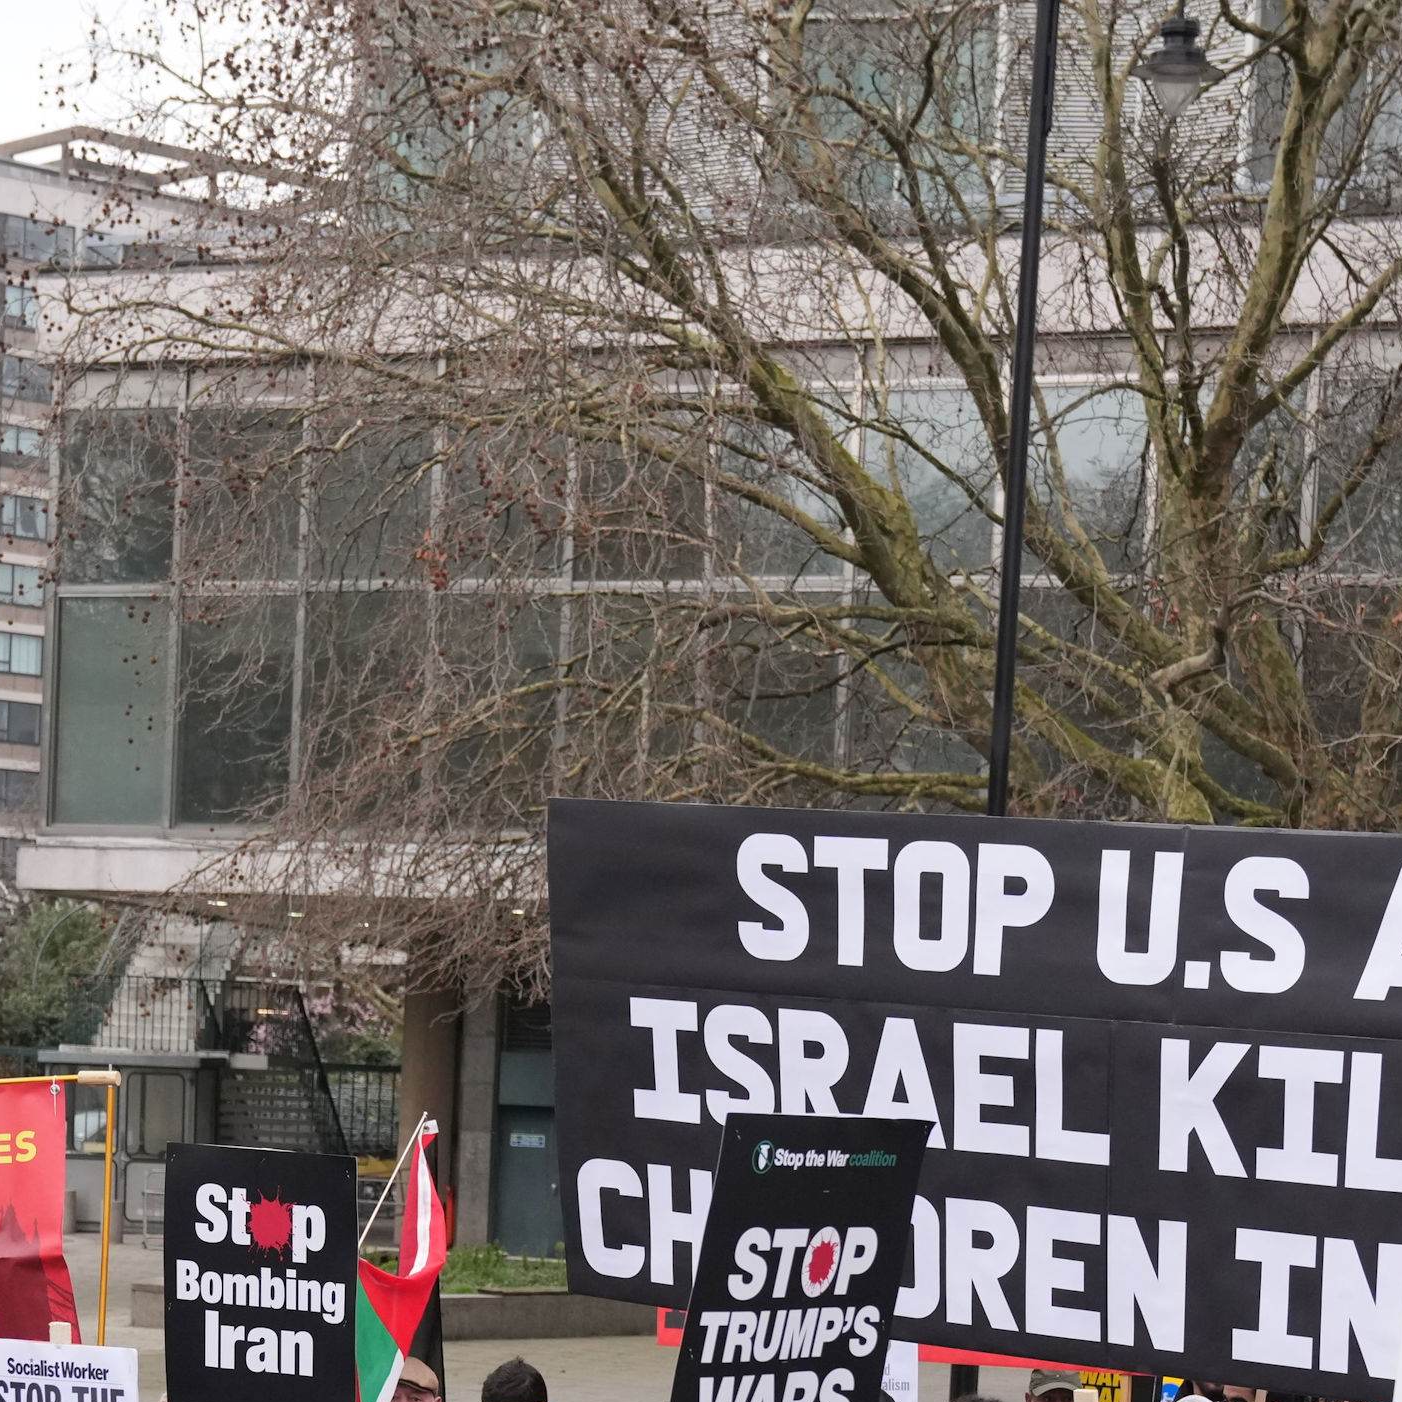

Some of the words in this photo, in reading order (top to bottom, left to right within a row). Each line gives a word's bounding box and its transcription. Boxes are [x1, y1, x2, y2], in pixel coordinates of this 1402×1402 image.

[737, 833, 1057, 975] STOP
[1097, 850, 1311, 994] U.S
[630, 996, 1112, 1167] ISRAEL
[774, 1148, 804, 1171] Stop
[806, 1150, 825, 1168] the
[826, 1150, 849, 1168] War
[849, 1151, 896, 1167] coalition
[575, 1157, 1190, 1351] CHDREN
[727, 1226, 878, 1301] STOP
[176, 1259, 346, 1324] Bombing
[204, 1309, 314, 1377] Iran
[699, 1305, 881, 1364] TRUMP'S
[61, 1361, 109, 1381] Worker
